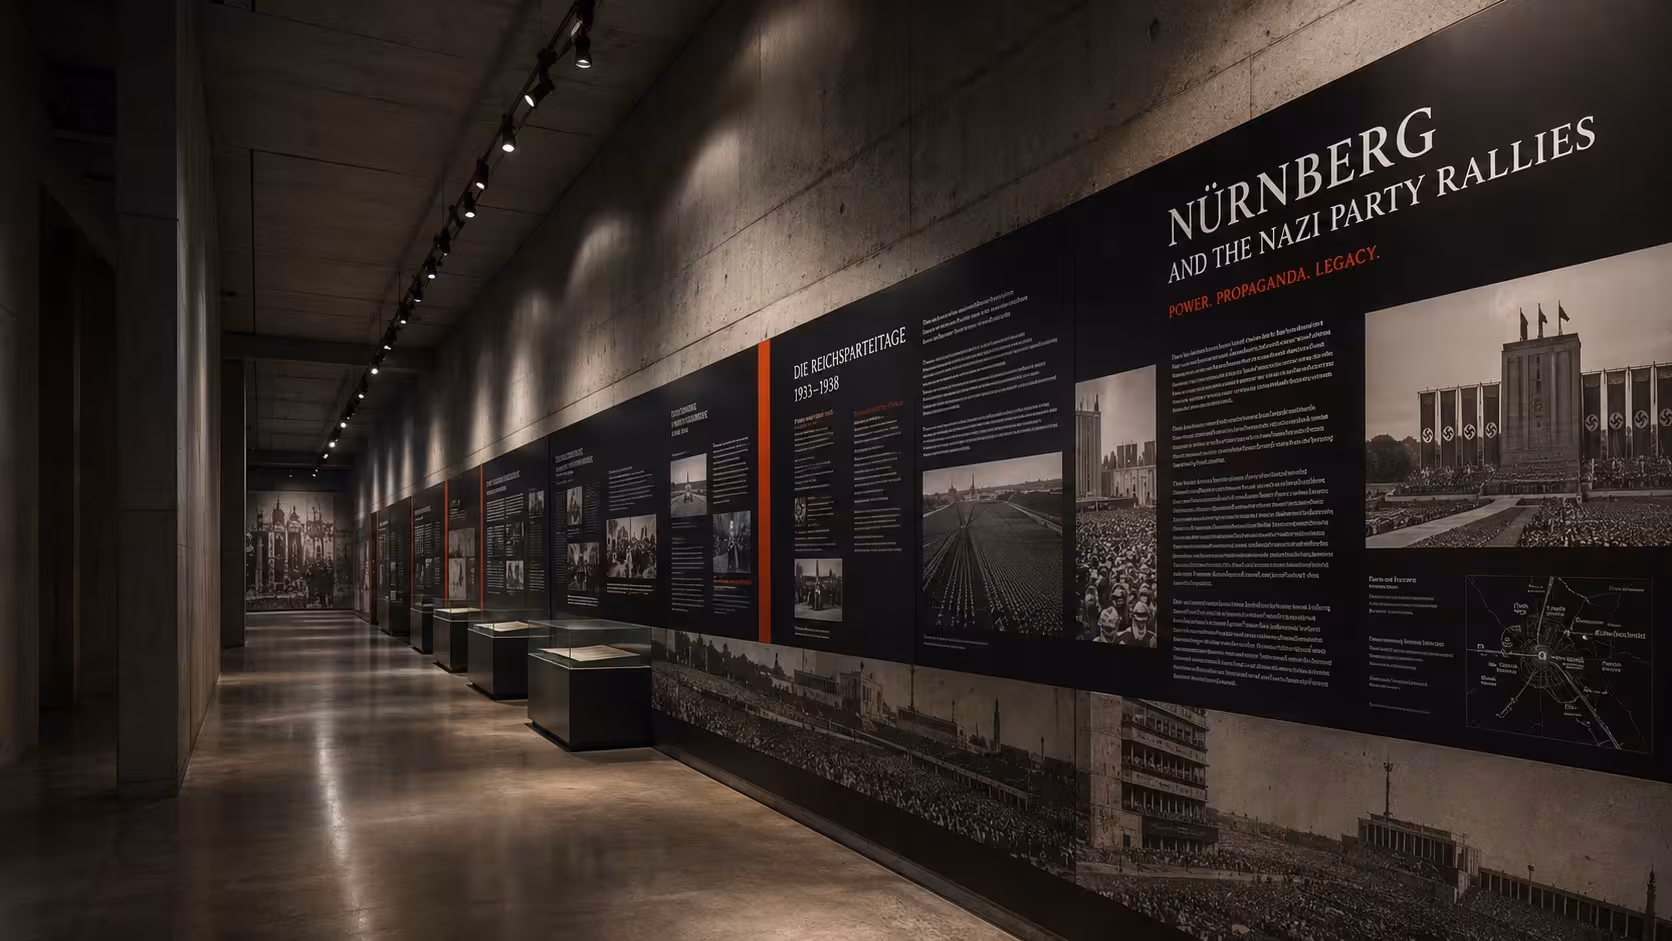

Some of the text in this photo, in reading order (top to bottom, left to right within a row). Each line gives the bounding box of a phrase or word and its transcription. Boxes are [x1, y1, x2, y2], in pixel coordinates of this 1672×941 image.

[1167, 106, 1437, 248] NÜRNBERG
[1168, 115, 1596, 284] AND THE NAZI PARTY RALLIES
[1168, 244, 1381, 319] POWER. PROPAGANDA. LEGACY.
[793, 326, 907, 380] DIE REICHSPARTEITAGE
[794, 375, 840, 403] 1933–1938
